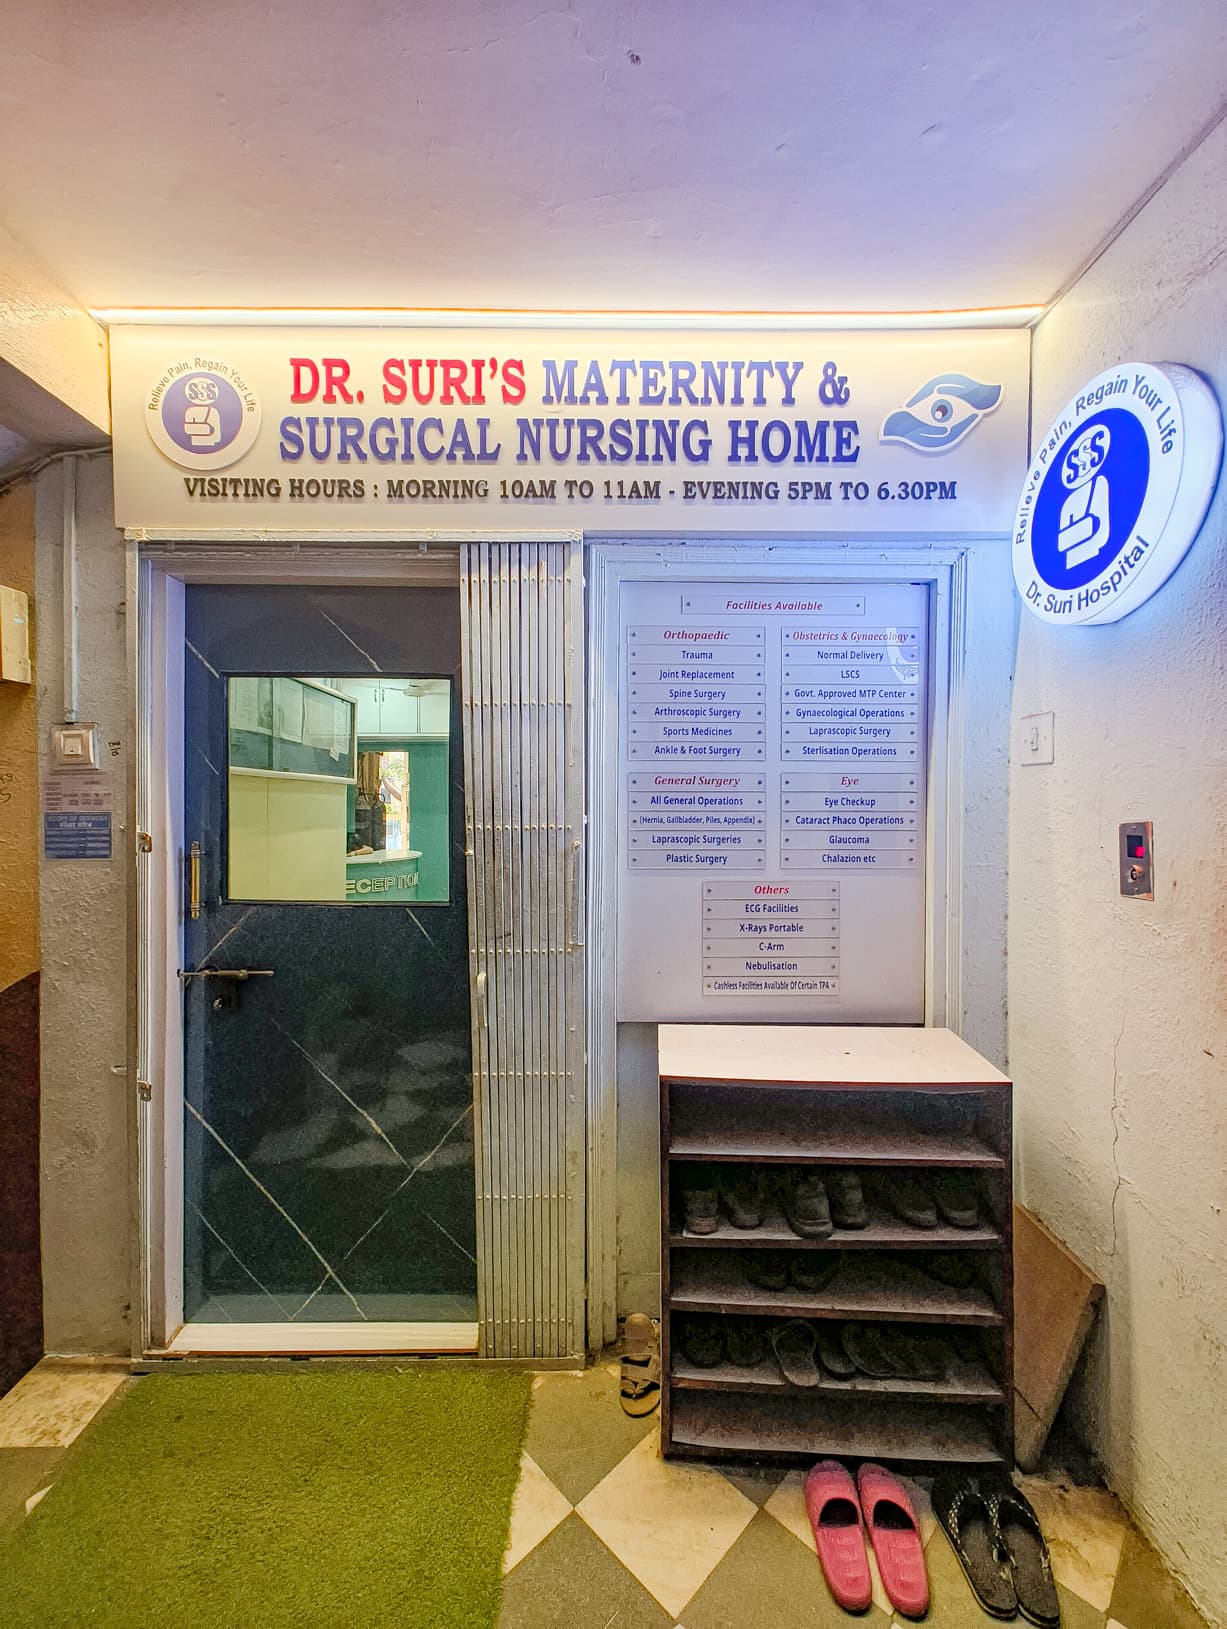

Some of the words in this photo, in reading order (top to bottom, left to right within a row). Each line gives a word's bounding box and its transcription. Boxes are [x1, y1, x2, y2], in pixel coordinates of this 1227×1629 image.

[168, 360, 193, 379] Pain,
[194, 357, 229, 375] Regain
[229, 369, 248, 392] Your
[243, 391, 258, 414] Life
[289, 357, 364, 404] DR.
[382, 357, 527, 406] SURI'S
[542, 359, 804, 406] MATERNITY
[818, 361, 851, 405] &
[279, 416, 501, 462] SURGICAL
[516, 418, 712, 463] NURSING
[728, 420, 860, 463] HOME
[1016, 470, 1041, 543] Relieve
[1039, 420, 1072, 464] Pain,
[1075, 375, 1128, 416] Regain
[1131, 374, 1163, 411] Your
[1157, 406, 1177, 454] Life
[184, 478, 281, 499] VISITING
[289, 479, 365, 499] HOURS
[386, 479, 489, 499] MORNING
[500, 479, 556, 499] 10AM
[565, 480, 594, 500] TO
[602, 480, 661, 500] 11AM
[683, 481, 779, 500] EVENING
[788, 481, 832, 500] 5PM
[840, 481, 869, 500] TO
[877, 481, 957, 500] 6.30PM
[1025, 581, 1041, 607] Dr.
[1044, 595, 1072, 614] Suri
[1077, 535, 1150, 611] Hospital
[726, 601, 772, 611] Facilities
[775, 601, 823, 611] Available
[664, 630, 730, 641] Orthopaedic
[793, 631, 839, 641] Obstetrics
[841, 632, 848, 641] &
[850, 631, 909, 643] Gynaecology
[681, 651, 713, 659] Trauma
[817, 650, 848, 659] Normal
[850, 650, 884, 661] Delivery
[659, 670, 679, 680] Joint
[681, 670, 735, 680] Replacement
[840, 670, 860, 679] LSCS
[669, 689, 692, 699] Spine
[694, 689, 726, 700] Surgery
[794, 689, 815, 699] Govt.
[818, 689, 856, 700] Approved
[859, 689, 876, 698] MTP
[879, 689, 906, 698] Center
[654, 707, 707, 718] Arthroscopic
[709, 707, 741, 719] Surgery
[796, 708, 857, 719] Gynaecological
[859, 708, 904, 719] Operations
[663, 726, 689, 737] Sports
[691, 726, 732, 736] Medicines
[809, 726, 857, 737] Laprascopic
[859, 726, 891, 738] Surgery
[655, 746, 678, 755] Ankle
[680, 746, 686, 755] &
[688, 746, 707, 755] Foot
[709, 746, 741, 757] Surgery
[852, 746, 897, 757] Operations
[654, 776, 696, 785] General
[699, 776, 740, 787] Surgery
[840, 776, 859, 787] Eye
[650, 796, 661, 805] All
[662, 796, 695, 805] General
[697, 796, 743, 807] Operations
[824, 797, 839, 808] Eye
[841, 797, 876, 808] Checkup
[666, 816, 704, 825] Gallbladder,
[705, 816, 722, 825] Piles,
[795, 816, 830, 825] Cataract
[832, 816, 856, 825] Phaco
[859, 816, 904, 827] Operations
[652, 835, 700, 846] Laprascopic
[702, 835, 741, 846] Surgeries
[829, 835, 870, 845] Glaucoma
[666, 854, 693, 864] Plastic
[695, 854, 728, 865] Surgery
[822, 854, 860, 864] Chalazion
[862, 855, 876, 864] etc
[754, 885, 789, 895] Others
[745, 904, 761, 913] ECG
[763, 904, 799, 913] Facilities
[739, 923, 767, 934] X-Rays
[769, 923, 804, 933] Portable
[759, 942, 785, 951] C-Arm
[745, 961, 798, 971] Nebulisation
[714, 981, 737, 990] Cashless
[739, 981, 762, 990] Facilities
[764, 981, 789, 990] Available
[790, 981, 797, 990] Of
[798, 981, 817, 990] Certain
[818, 981, 830, 990] TPA
